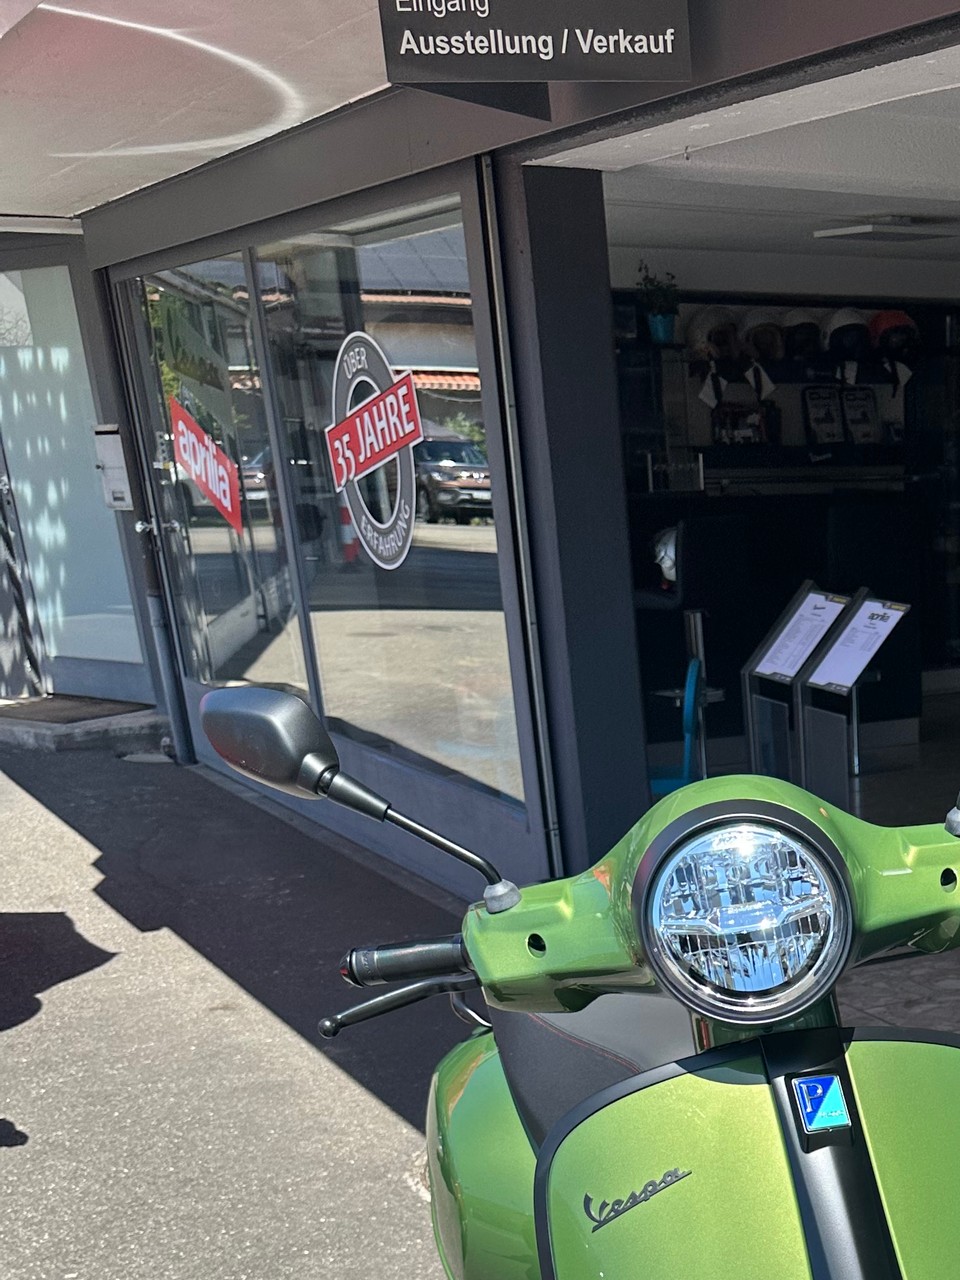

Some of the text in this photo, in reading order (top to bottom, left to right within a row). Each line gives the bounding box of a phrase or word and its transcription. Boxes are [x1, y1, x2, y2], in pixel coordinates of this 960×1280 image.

[400, 28, 675, 60] Ausstellung / Verkauf
[343, 348, 368, 379] ÜBER
[178, 420, 232, 512] aprilia
[333, 385, 415, 487] 35 JAHRE
[360, 499, 410, 557] ERFAHRUNG
[583, 1167, 692, 1233] Vespa
